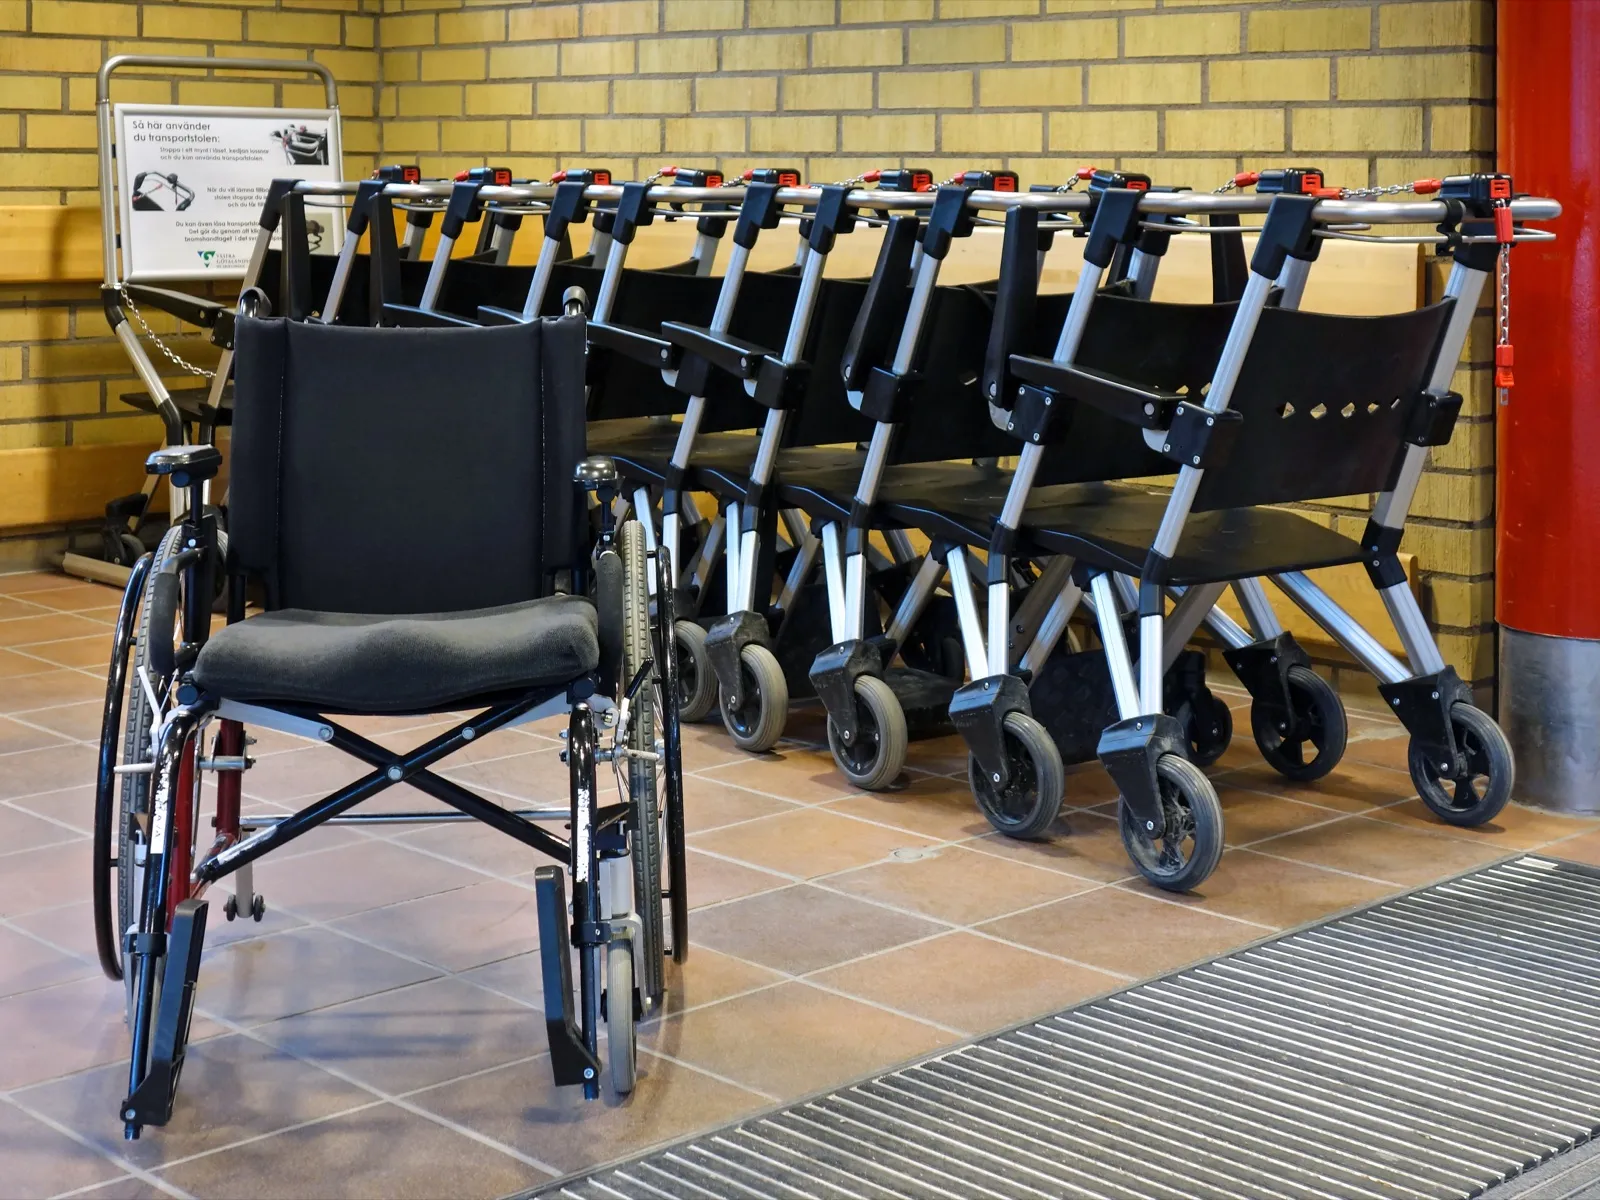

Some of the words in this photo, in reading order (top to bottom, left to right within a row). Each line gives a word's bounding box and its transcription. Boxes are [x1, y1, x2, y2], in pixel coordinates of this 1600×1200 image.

[132, 120, 144, 129] Så
[147, 120, 162, 129] här
[166, 122, 211, 130] använder
[133, 133, 146, 141] du
[149, 134, 220, 143] transportstolen:
